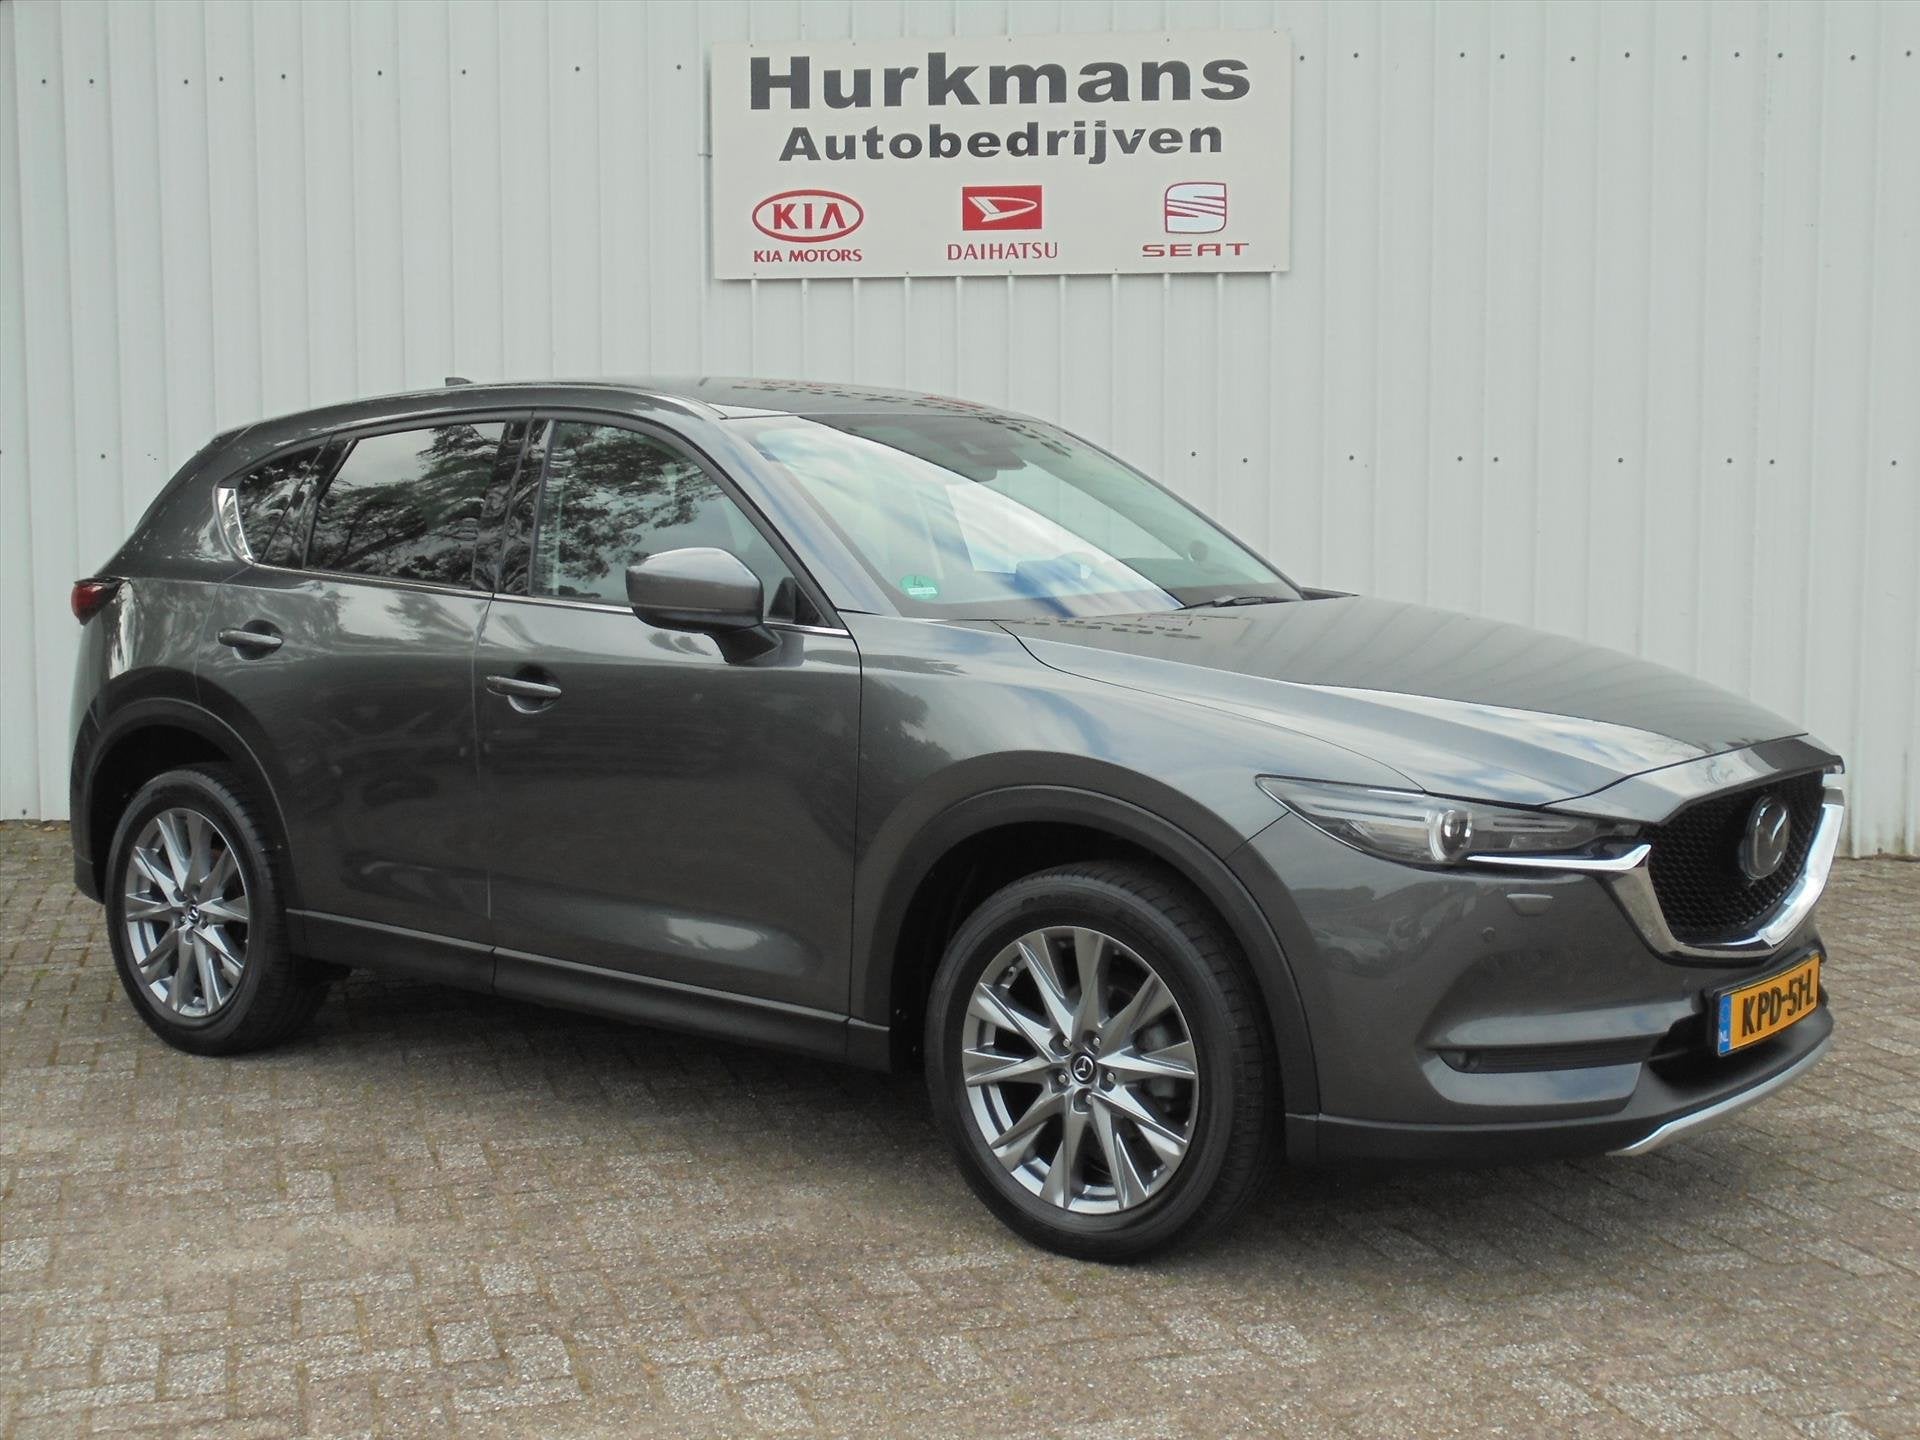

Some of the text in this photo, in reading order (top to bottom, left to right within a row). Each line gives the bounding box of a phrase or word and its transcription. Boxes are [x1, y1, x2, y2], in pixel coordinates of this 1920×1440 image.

[750, 52, 1251, 110] Hurkmans
[779, 120, 1222, 164] Autobedrijven
[773, 203, 847, 229] KIA
[754, 249, 862, 262] KIA MOTORS
[948, 243, 1057, 260] DAIHATSU
[1142, 243, 1249, 258] SEAT
